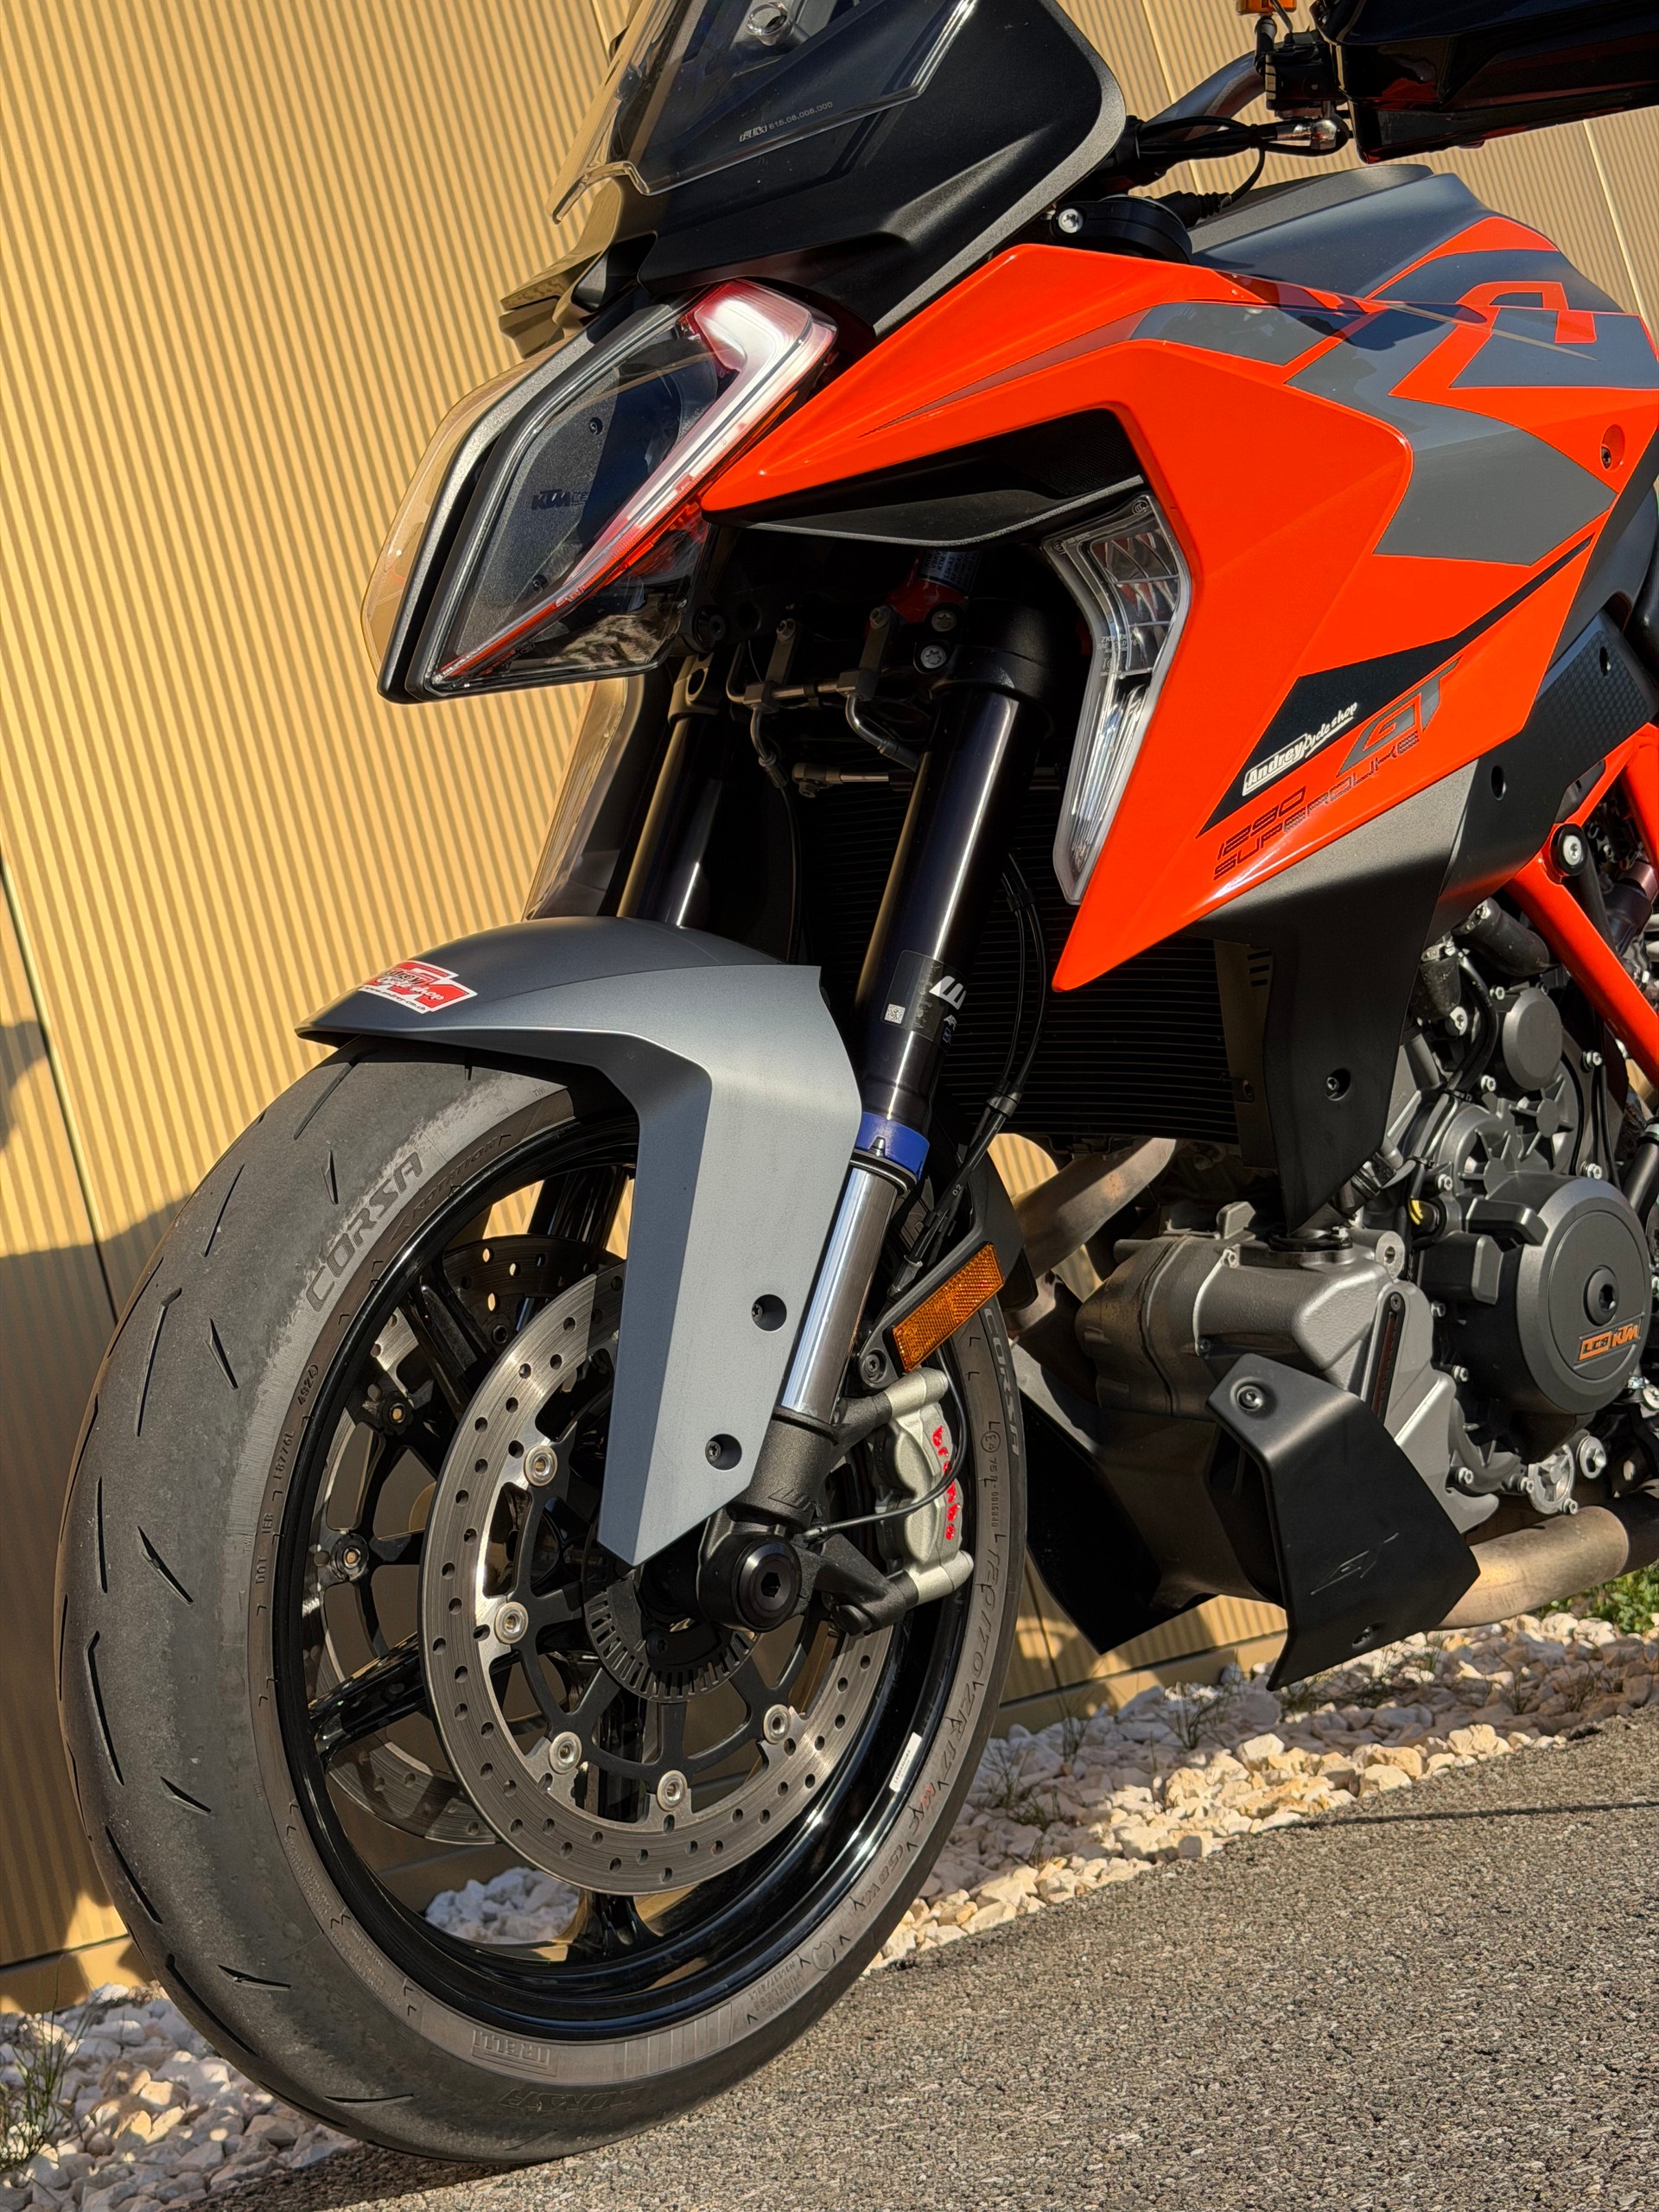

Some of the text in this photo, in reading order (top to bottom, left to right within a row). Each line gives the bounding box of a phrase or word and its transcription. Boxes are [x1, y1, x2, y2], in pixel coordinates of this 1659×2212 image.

[531, 488, 570, 511] KTM
[1337, 654, 1463, 778] GT
[1245, 737, 1306, 791] Andrey
[1217, 785, 1307, 861] 1290
[305, 1152, 423, 1313] CORSA
[1611, 1323, 1639, 1348] KTM
[983, 1307, 1020, 1457] CORSA
